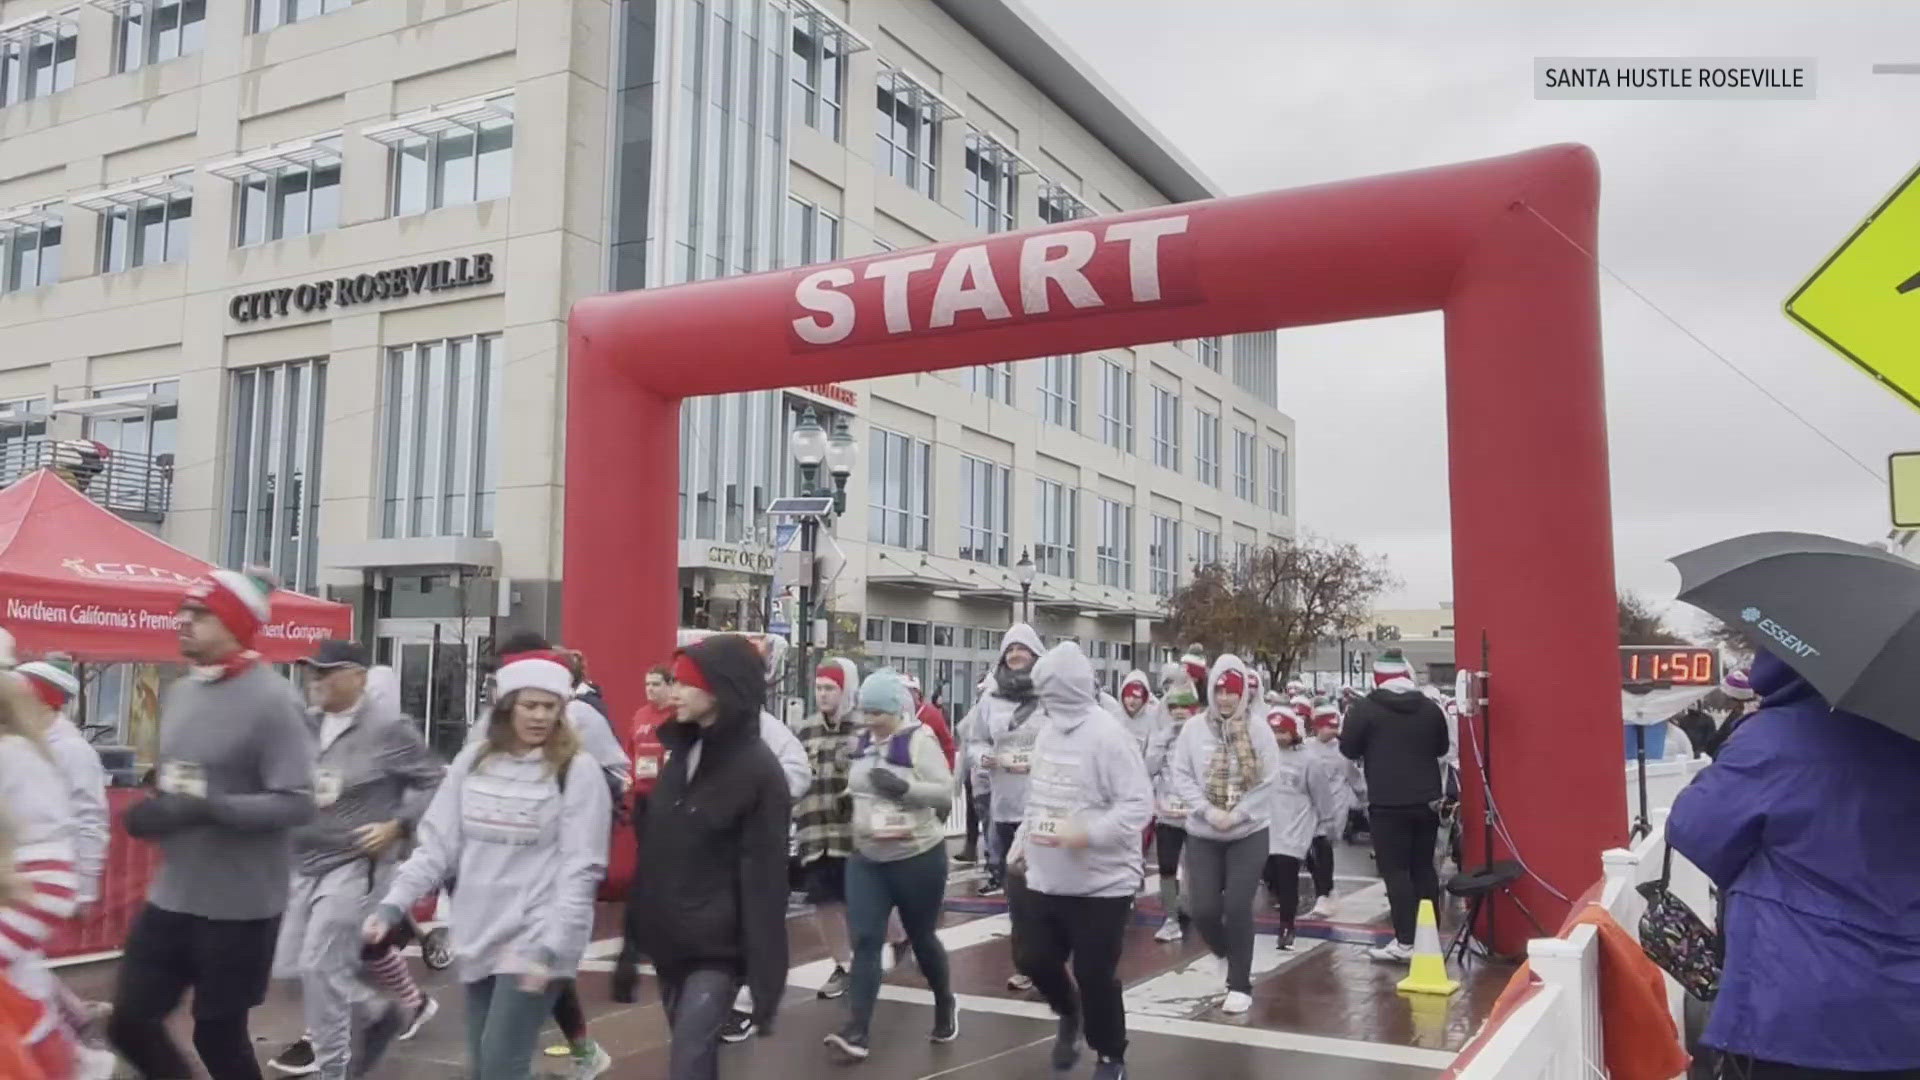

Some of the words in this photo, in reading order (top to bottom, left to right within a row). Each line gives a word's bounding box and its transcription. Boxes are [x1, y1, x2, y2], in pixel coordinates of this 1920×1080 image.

[229, 286, 294, 323] CITY
[293, 280, 334, 313] OF
[334, 252, 494, 307] ROSEVILLE
[792, 215, 1189, 345] START
[7, 598, 67, 623] Northern
[69, 604, 137, 629] California's
[286, 620, 333, 644] Company
[1758, 617, 1816, 658] ESSENT
